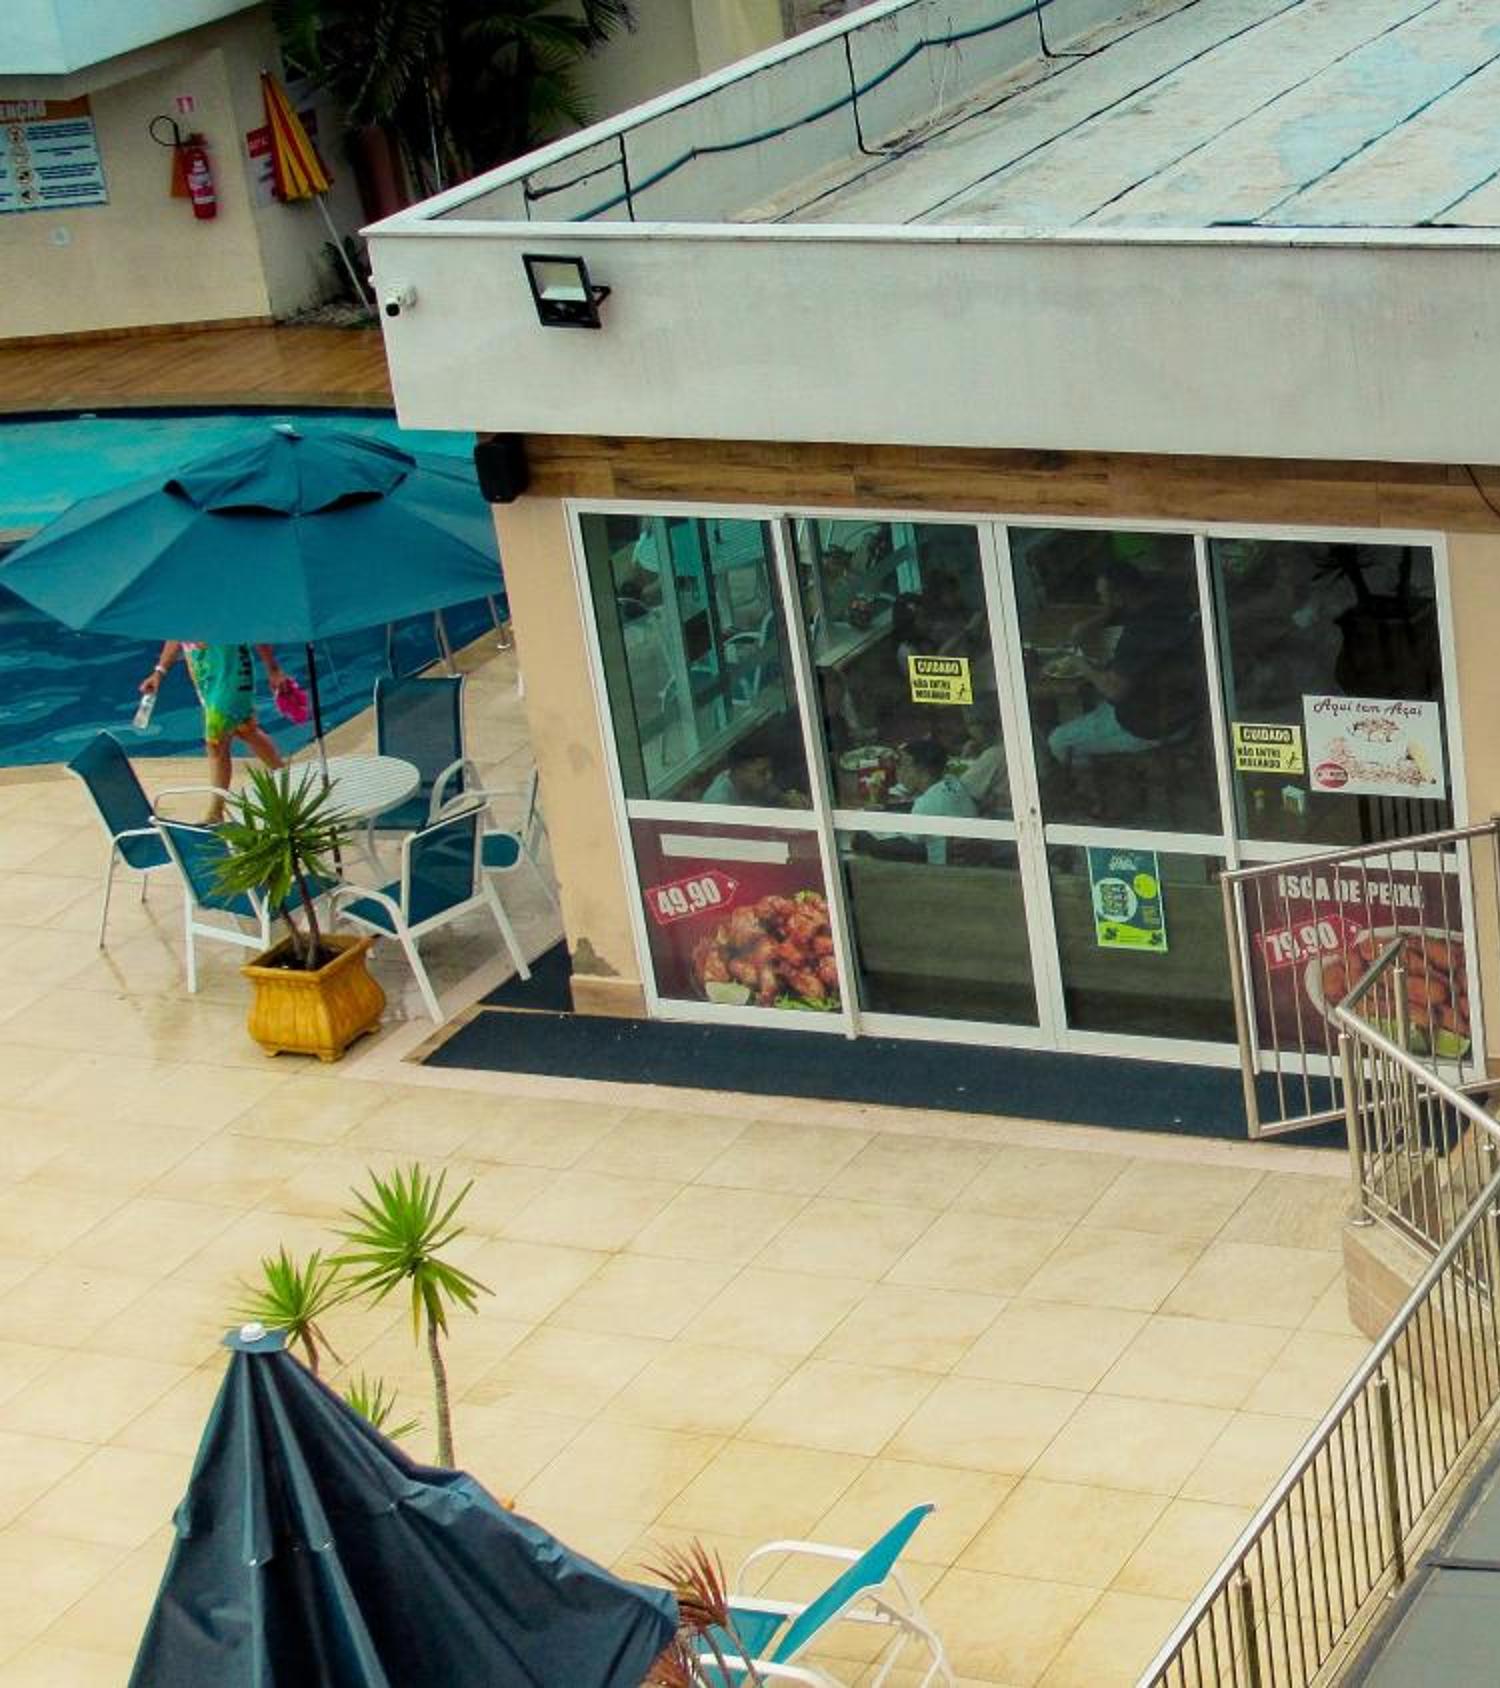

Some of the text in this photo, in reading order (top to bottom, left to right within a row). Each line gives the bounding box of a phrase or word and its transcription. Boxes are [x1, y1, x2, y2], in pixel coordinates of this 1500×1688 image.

[1313, 698, 1351, 717] Aqui
[1355, 703, 1381, 714] tem
[1243, 727, 1291, 743] CUIDADO
[658, 877, 721, 917] 49,90
[1278, 873, 1330, 900] ISCA
[1334, 878, 1361, 903] DE
[1267, 922, 1339, 962] 79,90
